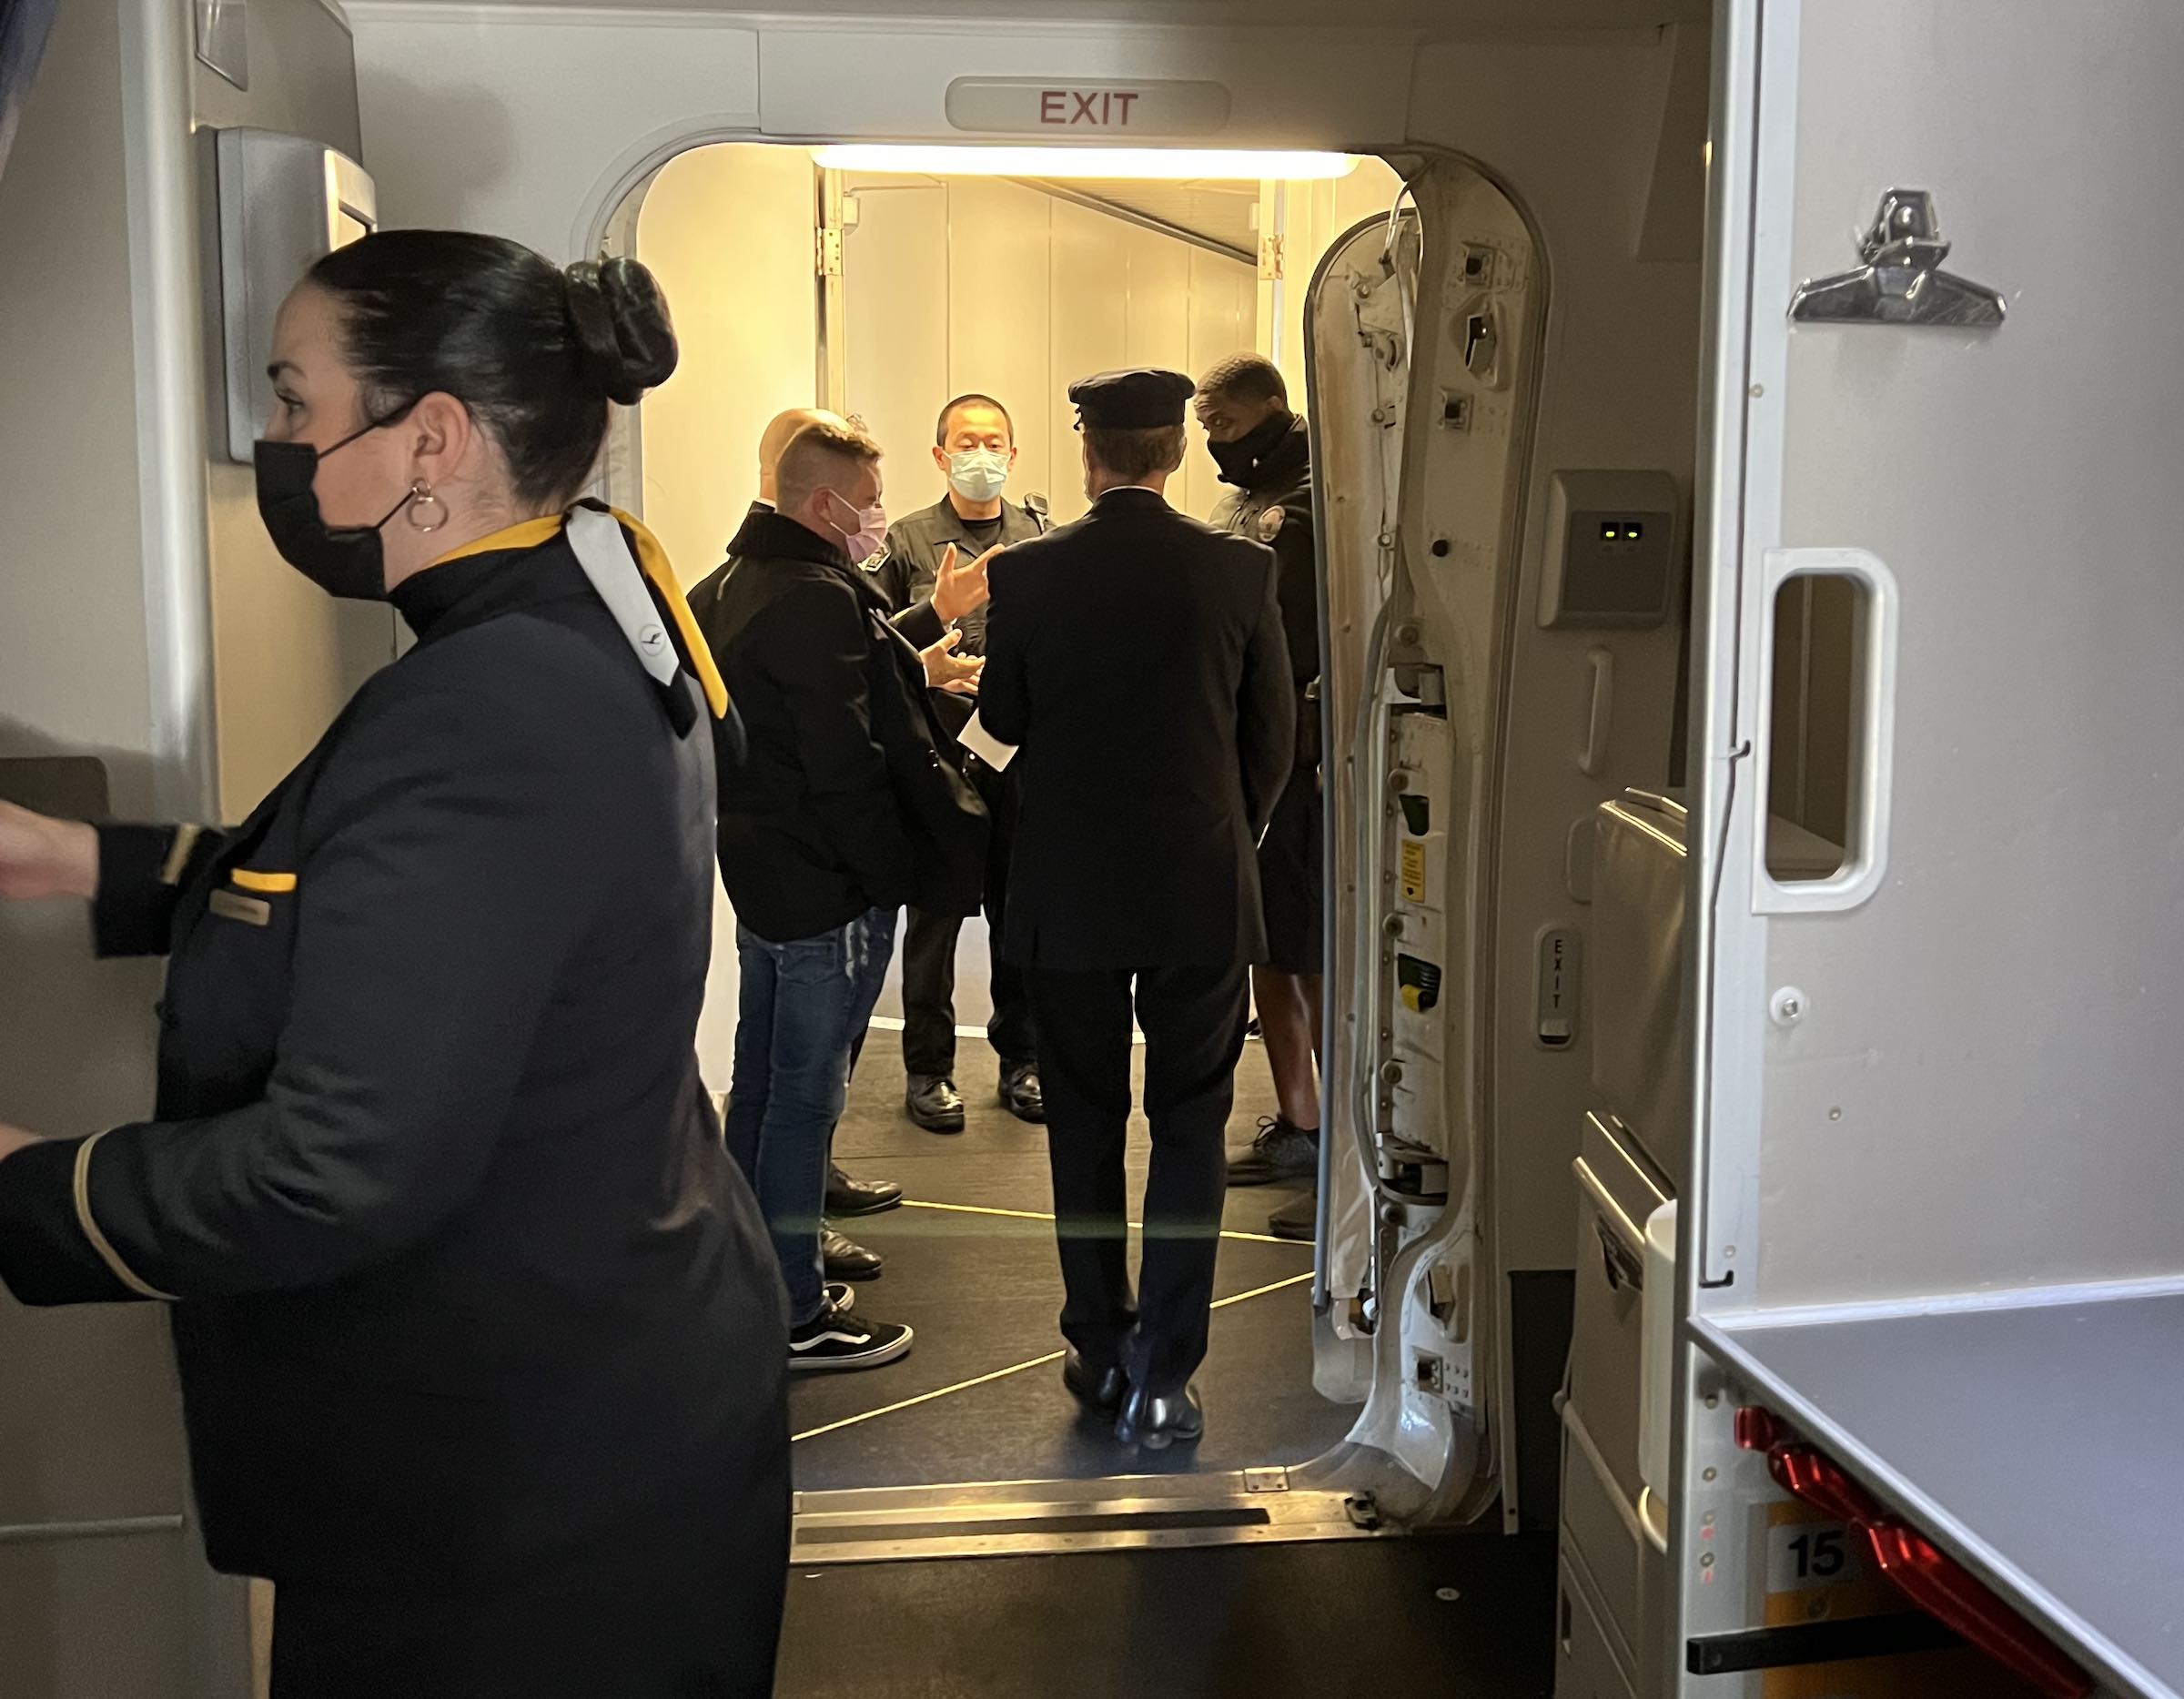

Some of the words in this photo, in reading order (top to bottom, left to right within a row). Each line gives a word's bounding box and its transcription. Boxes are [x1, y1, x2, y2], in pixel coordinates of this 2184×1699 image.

[1040, 90, 1138, 126] EXIT
[1552, 938, 1563, 1009] EXIT
[1788, 1530, 1845, 1578] 15
